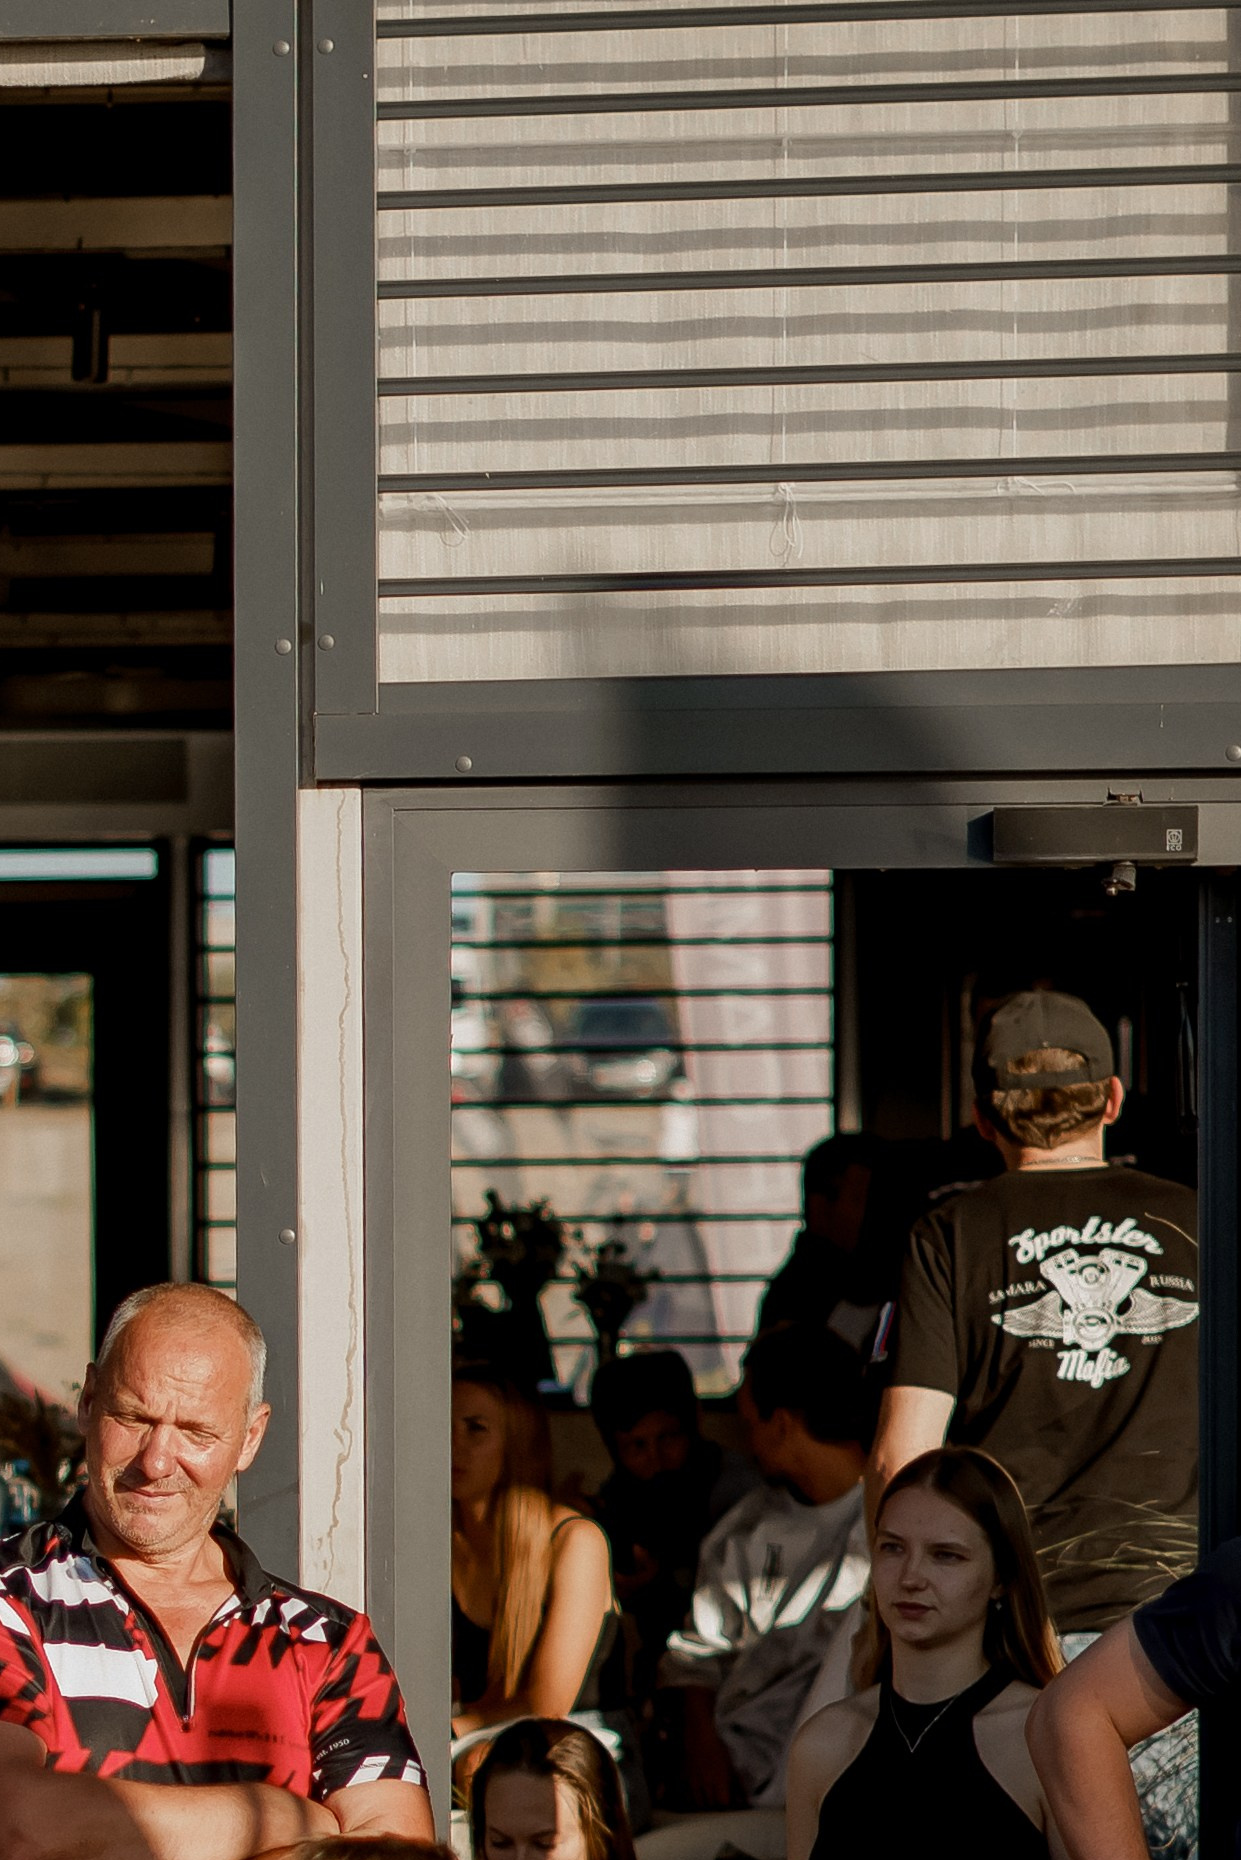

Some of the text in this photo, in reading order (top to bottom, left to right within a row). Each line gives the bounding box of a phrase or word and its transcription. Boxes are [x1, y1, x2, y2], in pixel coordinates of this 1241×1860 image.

[1009, 1215, 1164, 1264] Sportster
[1149, 1274, 1195, 1293] RUSSIA
[1057, 1348, 1131, 1389] Mafia
[329, 1738, 350, 1751] 1950
